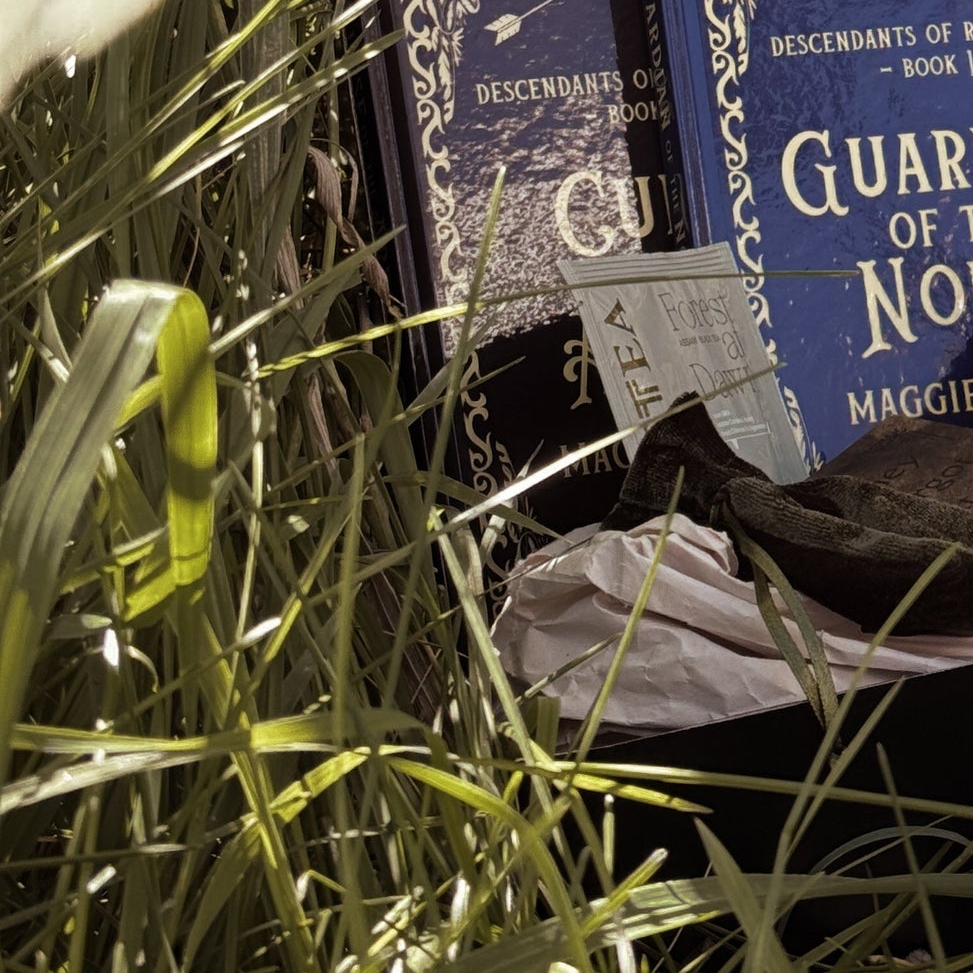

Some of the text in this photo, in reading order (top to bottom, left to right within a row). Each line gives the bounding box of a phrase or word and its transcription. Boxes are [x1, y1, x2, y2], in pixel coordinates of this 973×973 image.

[770, 25, 917, 58] DESCENDANTS
[926, 22, 952, 44] OF
[902, 54, 958, 78] BOOK
[476, 70, 625, 105] DESCENDANTS
[889, 208, 938, 249] OF
[658, 291, 735, 332] Forest
[914, 457, 973, 499] rgot
